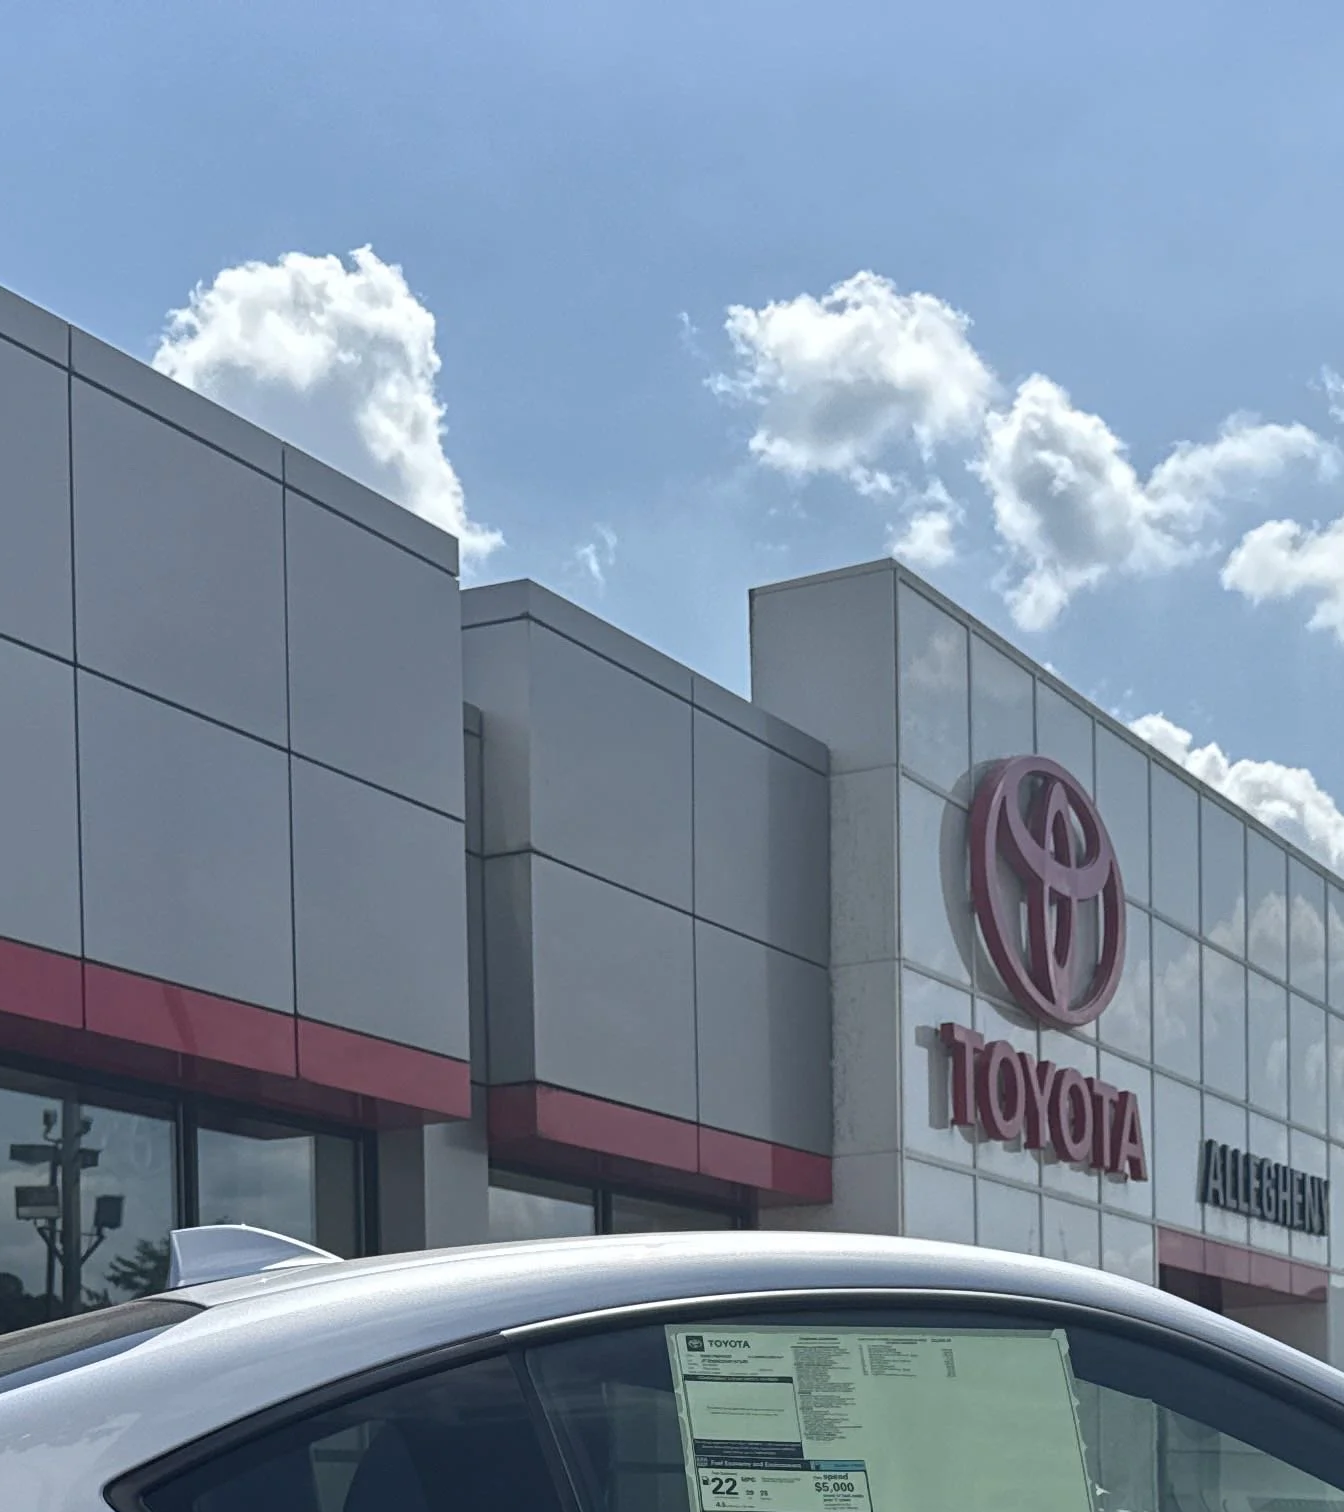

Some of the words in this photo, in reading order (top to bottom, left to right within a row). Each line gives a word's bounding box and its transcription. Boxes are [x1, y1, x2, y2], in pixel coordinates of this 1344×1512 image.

[940, 1022, 1148, 1182] TOYOTA
[1202, 1139, 1330, 1237] ALLEGHENY
[707, 1339, 751, 1349] TOYOTA
[711, 1477, 739, 1495] 22
[814, 1482, 855, 1493] $5,000
